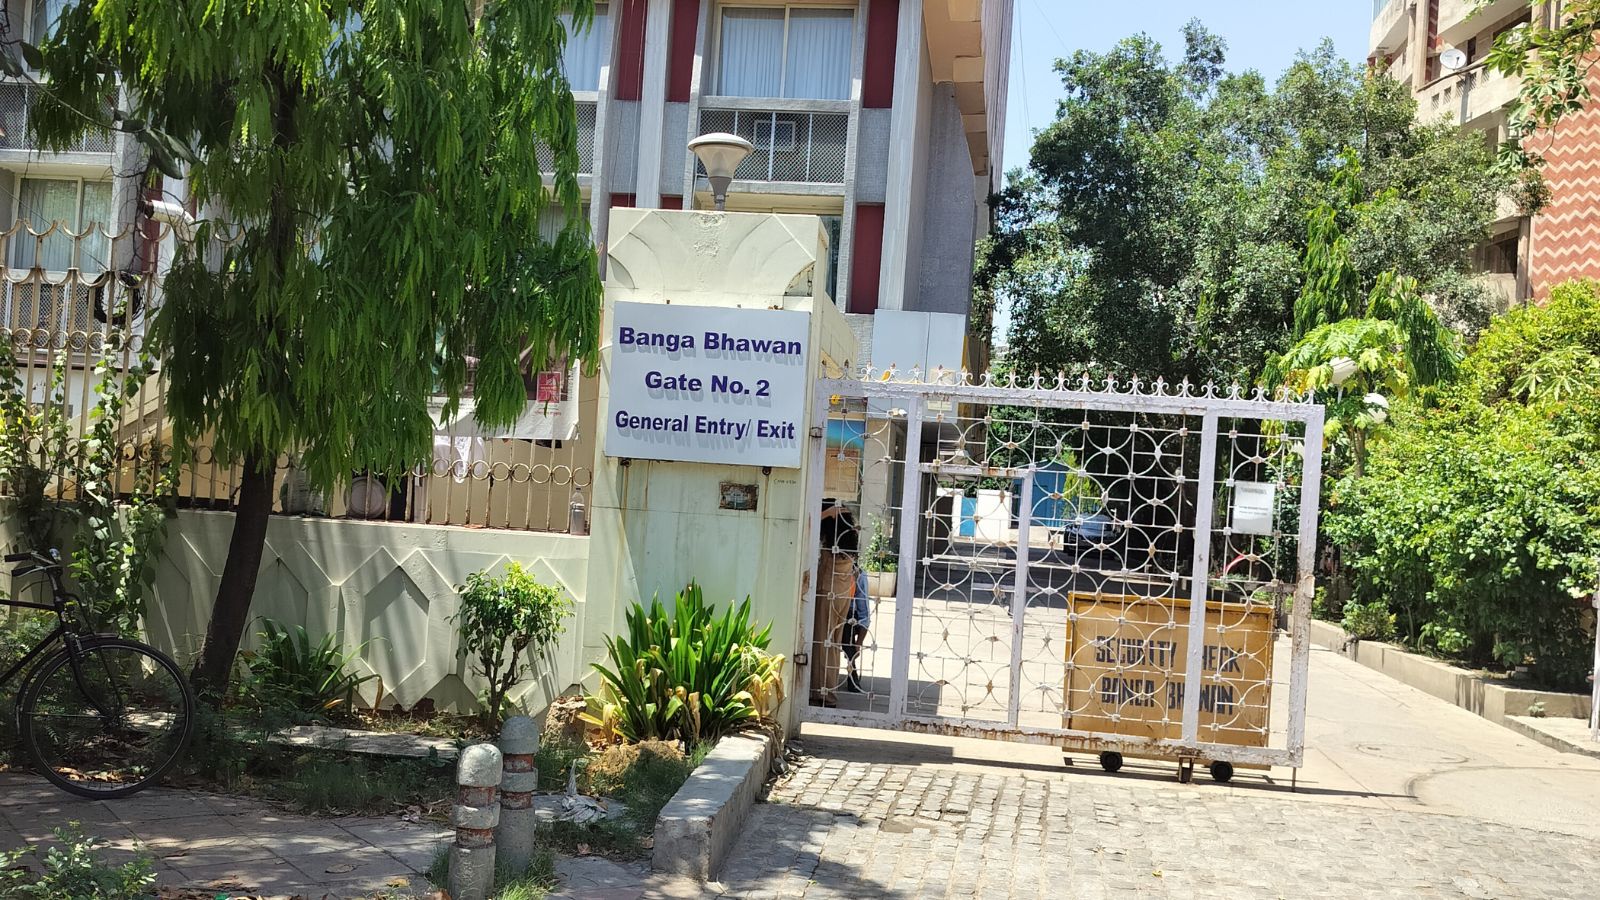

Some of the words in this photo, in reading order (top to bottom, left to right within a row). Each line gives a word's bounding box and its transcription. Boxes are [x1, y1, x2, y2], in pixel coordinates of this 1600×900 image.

[619, 327, 695, 352] Banga
[704, 332, 802, 355] Bhawan
[645, 371, 703, 392] Gate
[711, 375, 750, 395] No.
[756, 379, 770, 396] 2
[615, 410, 689, 432] General
[695, 416, 751, 440] Entry/
[757, 420, 795, 440] Exit
[1096, 635, 1177, 668] SECURITY
[1197, 644, 1242, 673] HECK
[1167, 681, 1233, 715] BHWAN
